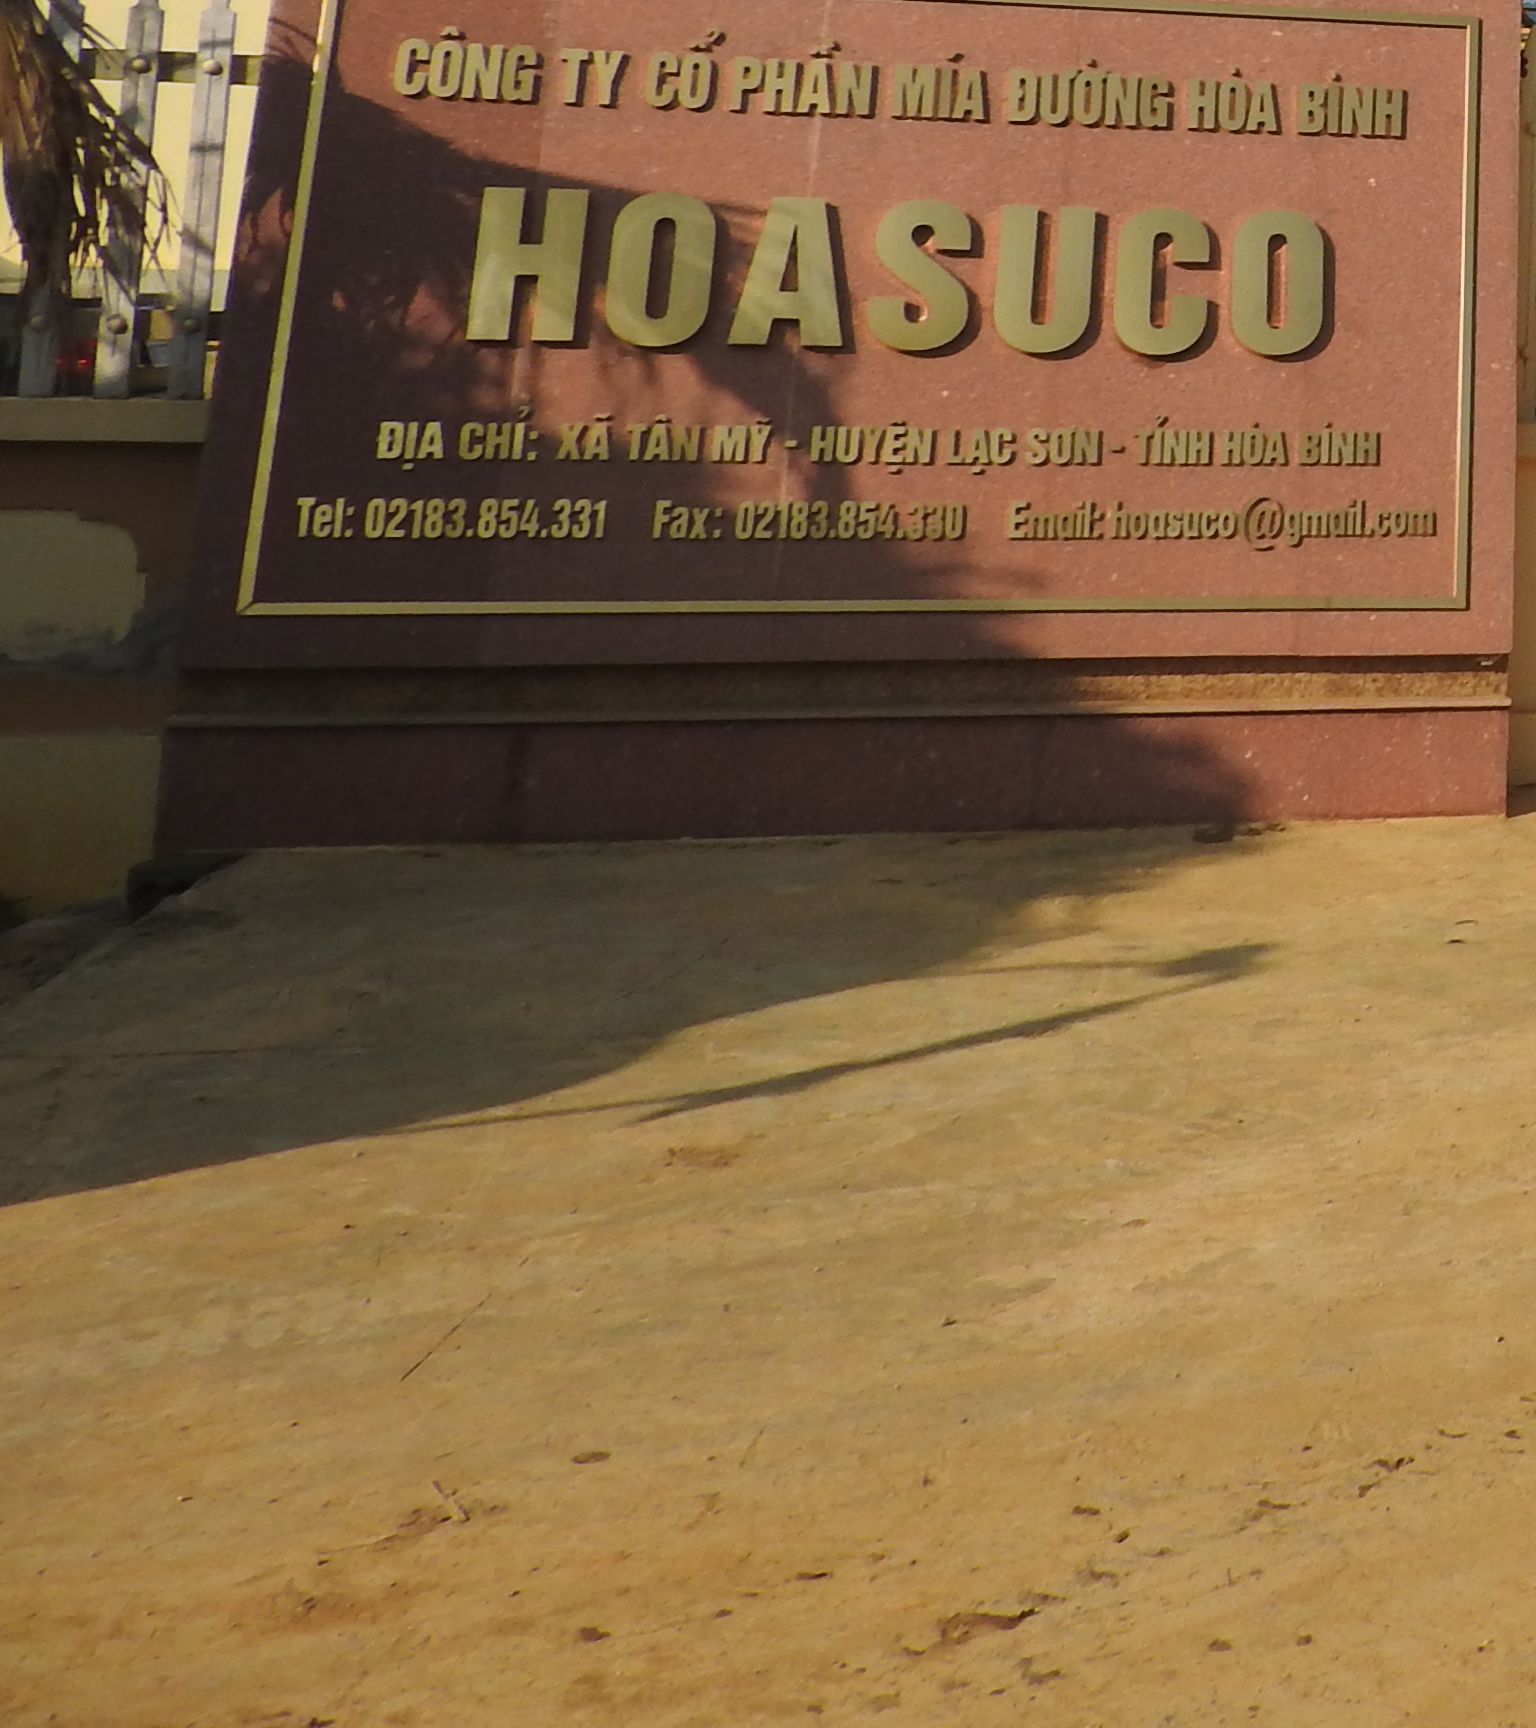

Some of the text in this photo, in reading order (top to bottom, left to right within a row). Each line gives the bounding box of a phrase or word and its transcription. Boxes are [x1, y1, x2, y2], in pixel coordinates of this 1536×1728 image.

[394, 26, 541, 103] CÔNG
[560, 47, 629, 106] TY
[645, 29, 726, 111] CỔ
[891, 52, 989, 123] MÍA
[1007, 57, 1174, 129] ĐƯỜNG
[1187, 66, 1281, 135] HÒA
[1297, 71, 1407, 139] BÌNH
[465, 185, 1335, 360] HOASUCO
[376, 420, 444, 471] ĐỊA
[457, 405, 539, 461] CHỈ:
[555, 413, 614, 461] XÃ
[626, 413, 702, 462] TÂN
[711, 417, 775, 464] MỸ
[809, 421, 934, 476] HUYỆN
[946, 426, 1016, 475] LẠC
[1025, 426, 1103, 467] SƠN
[1134, 415, 1214, 466] TỈNH
[1220, 421, 1289, 467] HÒA
[1299, 422, 1381, 467] BÌNH
[296, 495, 1438, 551] Tel: 02183.854.331 Fax: 02183.854.330 Email: hoasuco@gmail.com
